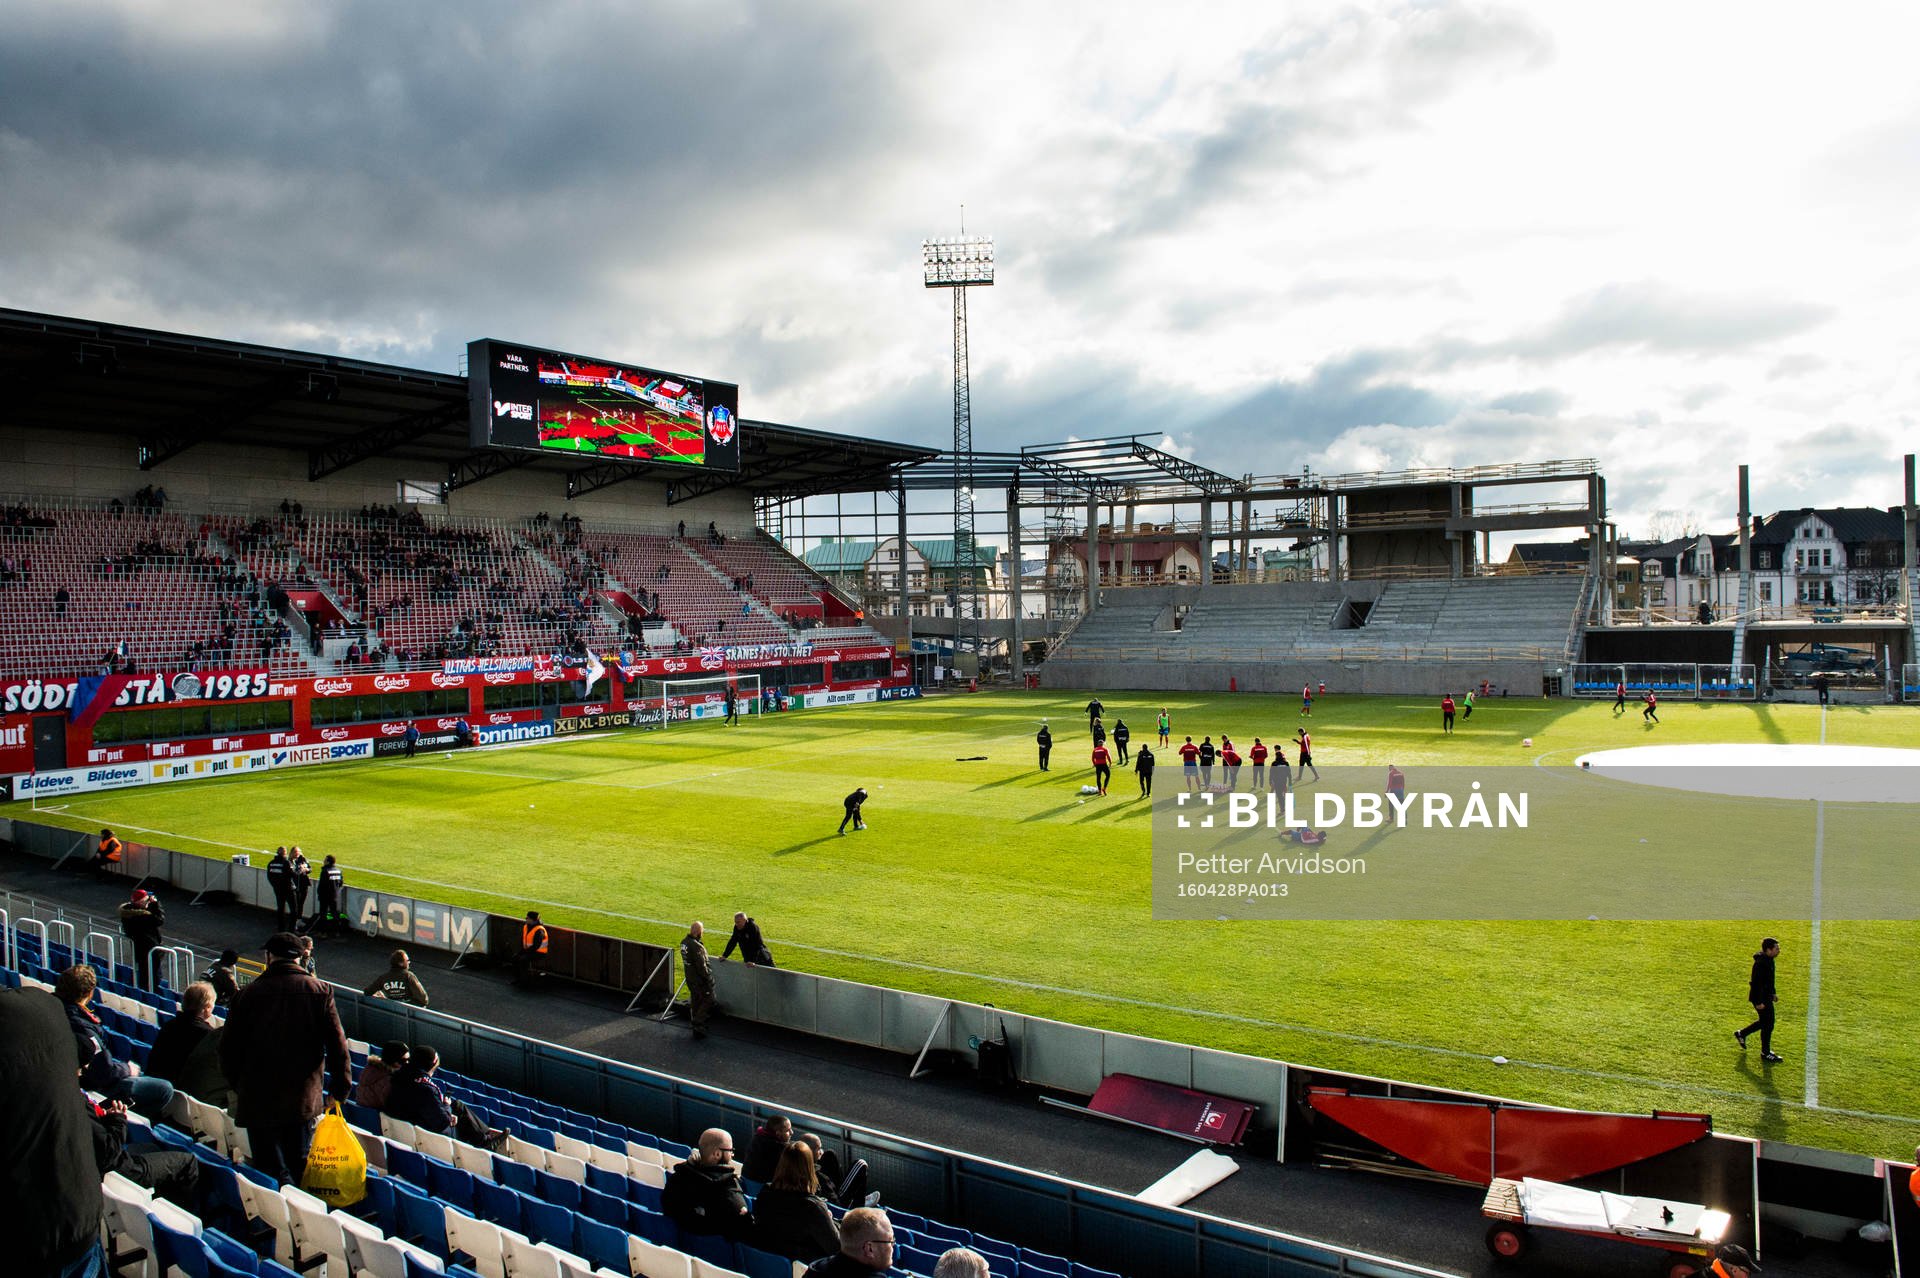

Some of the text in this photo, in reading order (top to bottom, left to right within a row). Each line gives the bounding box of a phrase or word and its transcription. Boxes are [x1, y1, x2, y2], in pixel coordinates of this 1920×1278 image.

[506, 353, 523, 363] VÅRA
[499, 361, 529, 373] PARTNERS
[510, 402, 533, 413] INTER
[510, 411, 533, 421] SPORT
[445, 656, 534, 674] ULTRAS HELSINGBORG
[205, 673, 268, 699] 1985
[313, 678, 353, 696] Carlsberg
[374, 675, 411, 692] Carlsberg
[431, 672, 465, 688] Carlsberg
[489, 713, 512, 725] Carlsberg
[666, 707, 689, 721] FÄRG
[579, 714, 630, 730] XL-BYGG
[321, 728, 349, 741] Carlsberg
[289, 743, 369, 763] INTERSPORT
[88, 768, 138, 782] Bildeve
[383, 980, 406, 991] GML
